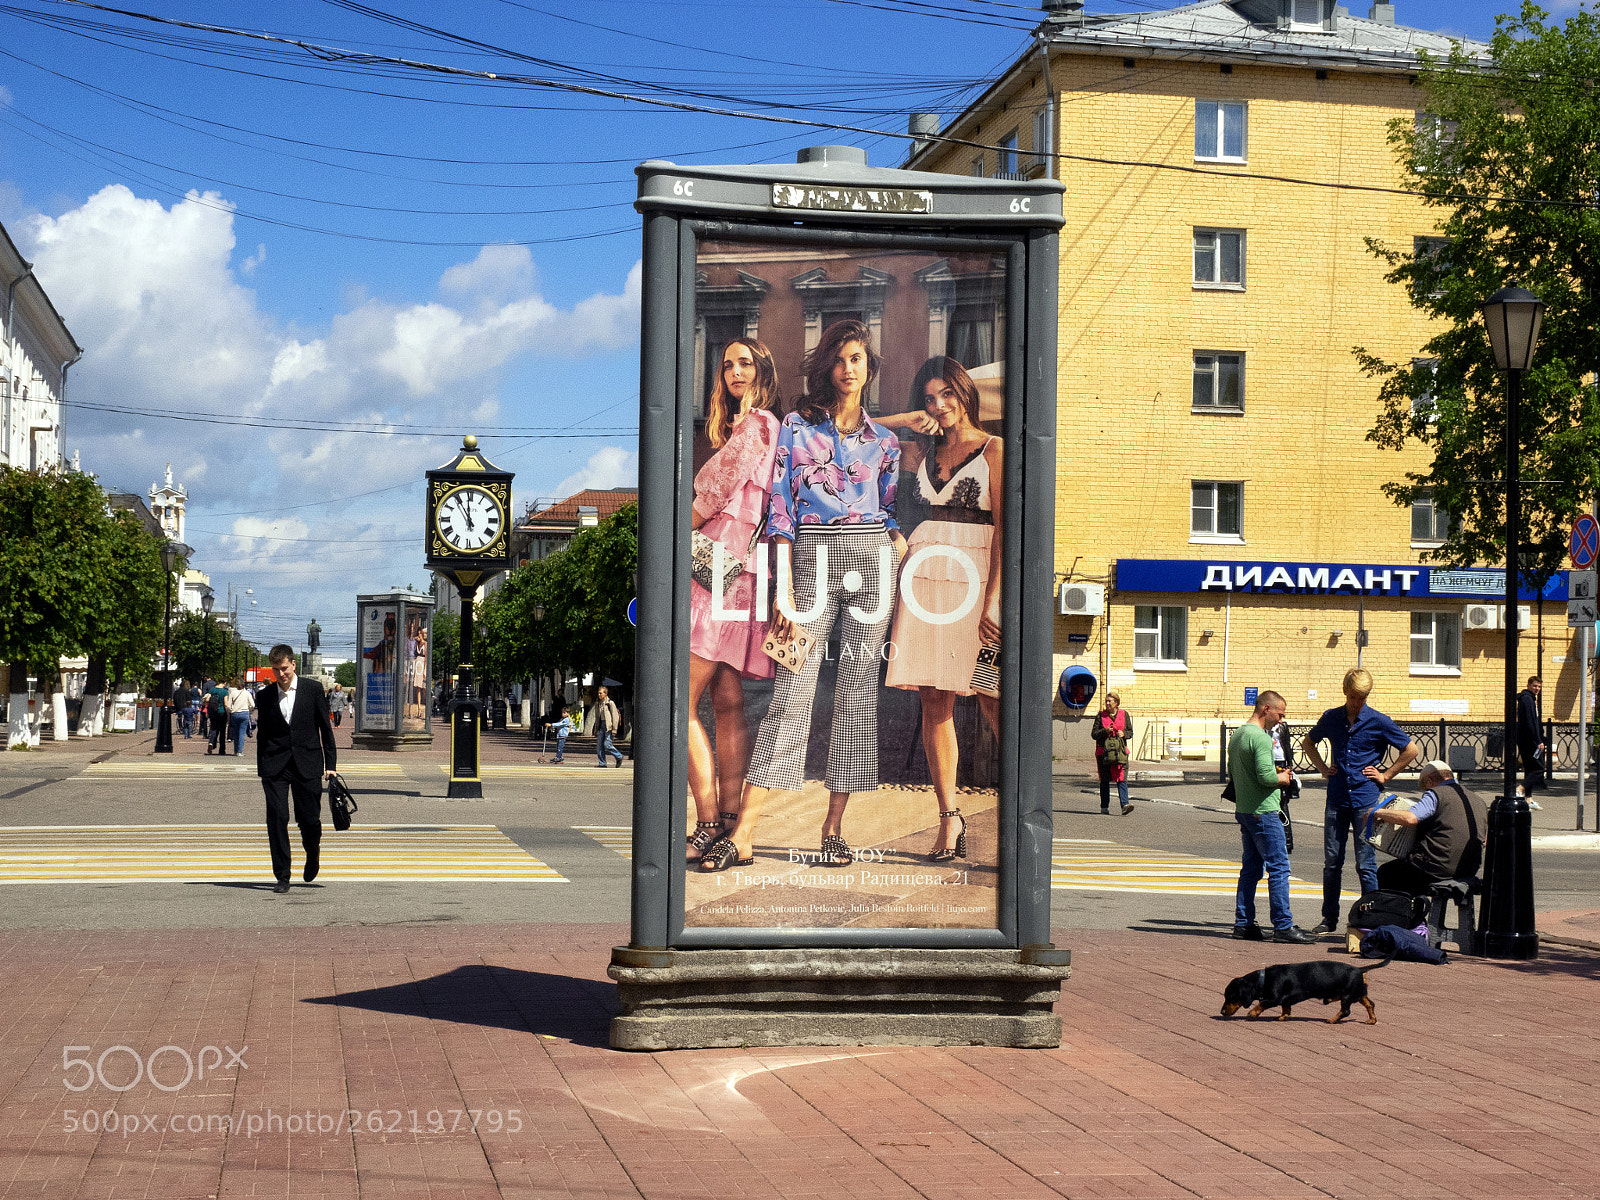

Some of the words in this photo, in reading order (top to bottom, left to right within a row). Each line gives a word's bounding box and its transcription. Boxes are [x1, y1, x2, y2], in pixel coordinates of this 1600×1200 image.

[1201, 565, 1420, 591] ДИАМАНТ
[791, 640, 899, 662] MILANO
[788, 848, 840, 866] Бутик
[716, 874, 728, 887] г.
[731, 871, 785, 890] Тверь,
[789, 870, 855, 890] бульвар
[952, 870, 969, 886] 21
